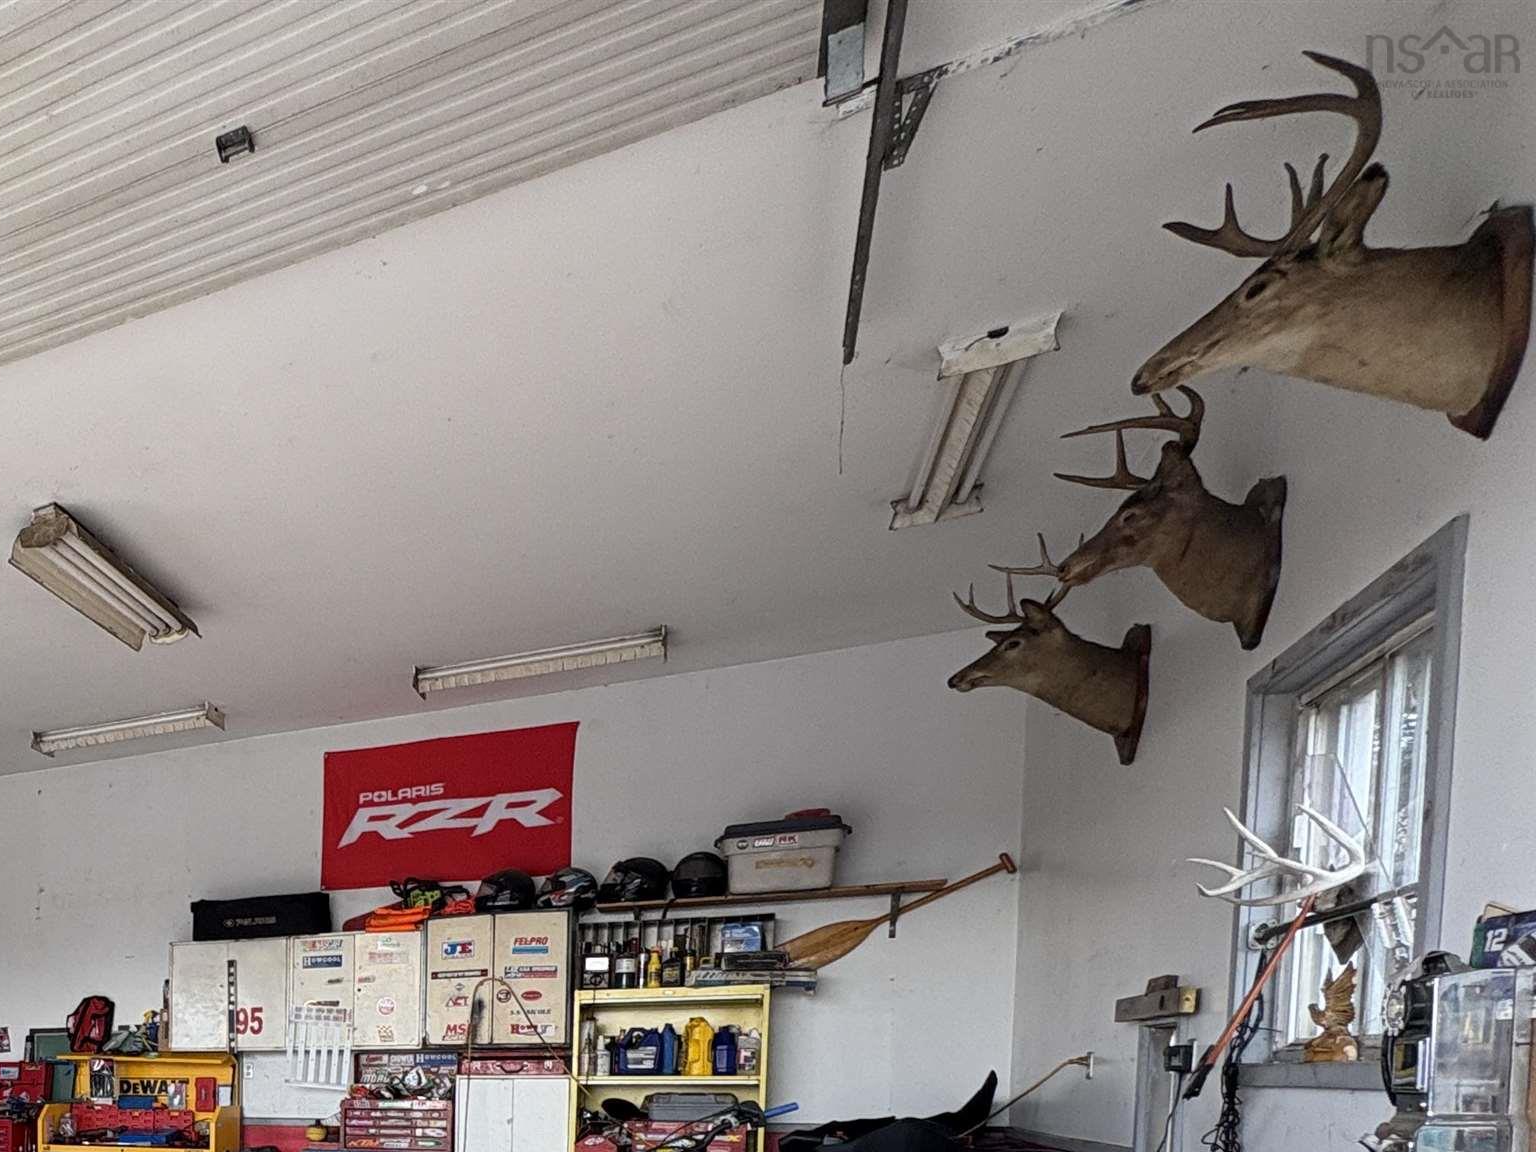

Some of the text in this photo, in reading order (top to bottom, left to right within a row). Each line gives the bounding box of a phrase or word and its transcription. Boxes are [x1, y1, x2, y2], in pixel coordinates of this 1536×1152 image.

[357, 782, 446, 805] POLARIS
[336, 787, 564, 850] RZR
[444, 941, 473, 955] JE
[1484, 927, 1509, 953] 12
[235, 1006, 264, 1036] 95
[445, 1023, 473, 1035] MS
